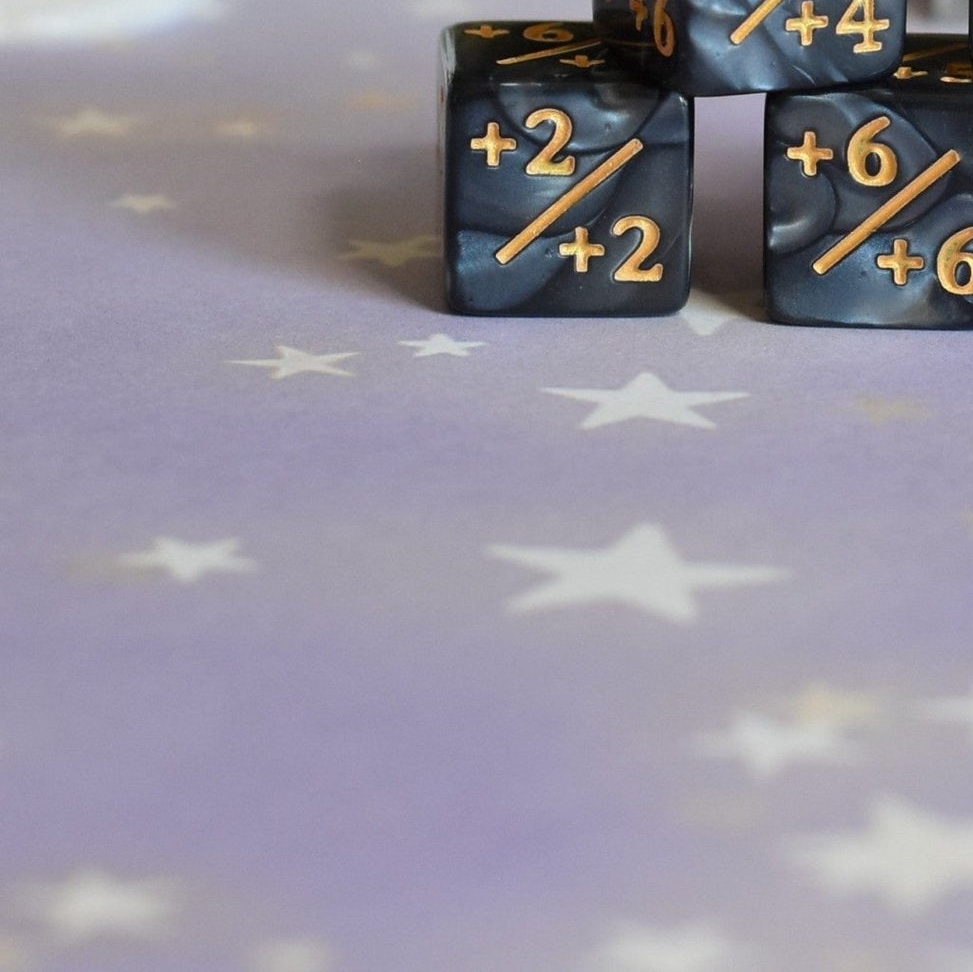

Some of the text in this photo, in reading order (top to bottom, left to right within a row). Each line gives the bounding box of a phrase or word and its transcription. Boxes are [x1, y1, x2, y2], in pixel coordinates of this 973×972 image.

[469, 108, 576, 176] +2
[785, 115, 898, 187] +6
[558, 214, 664, 283] +2
